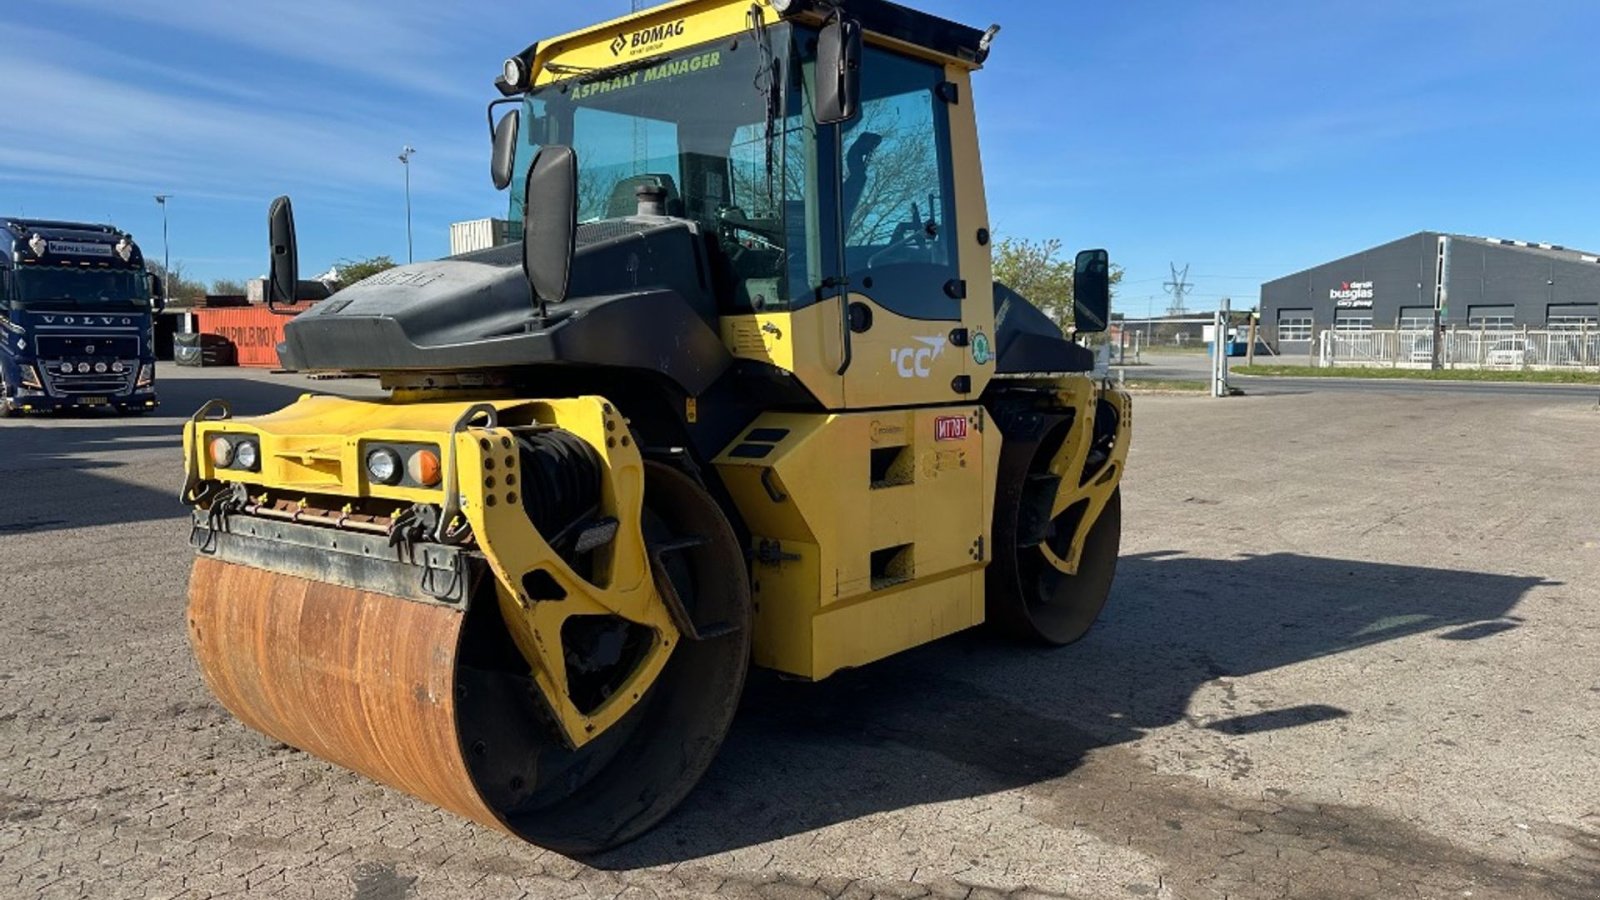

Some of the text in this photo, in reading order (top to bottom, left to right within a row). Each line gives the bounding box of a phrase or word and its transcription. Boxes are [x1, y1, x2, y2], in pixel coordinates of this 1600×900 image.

[631, 19, 684, 48] BOMAG
[571, 52, 720, 100] ASPHALT MANAGER
[1329, 288, 1373, 300] busglas
[42, 315, 131, 325] VOLVO
